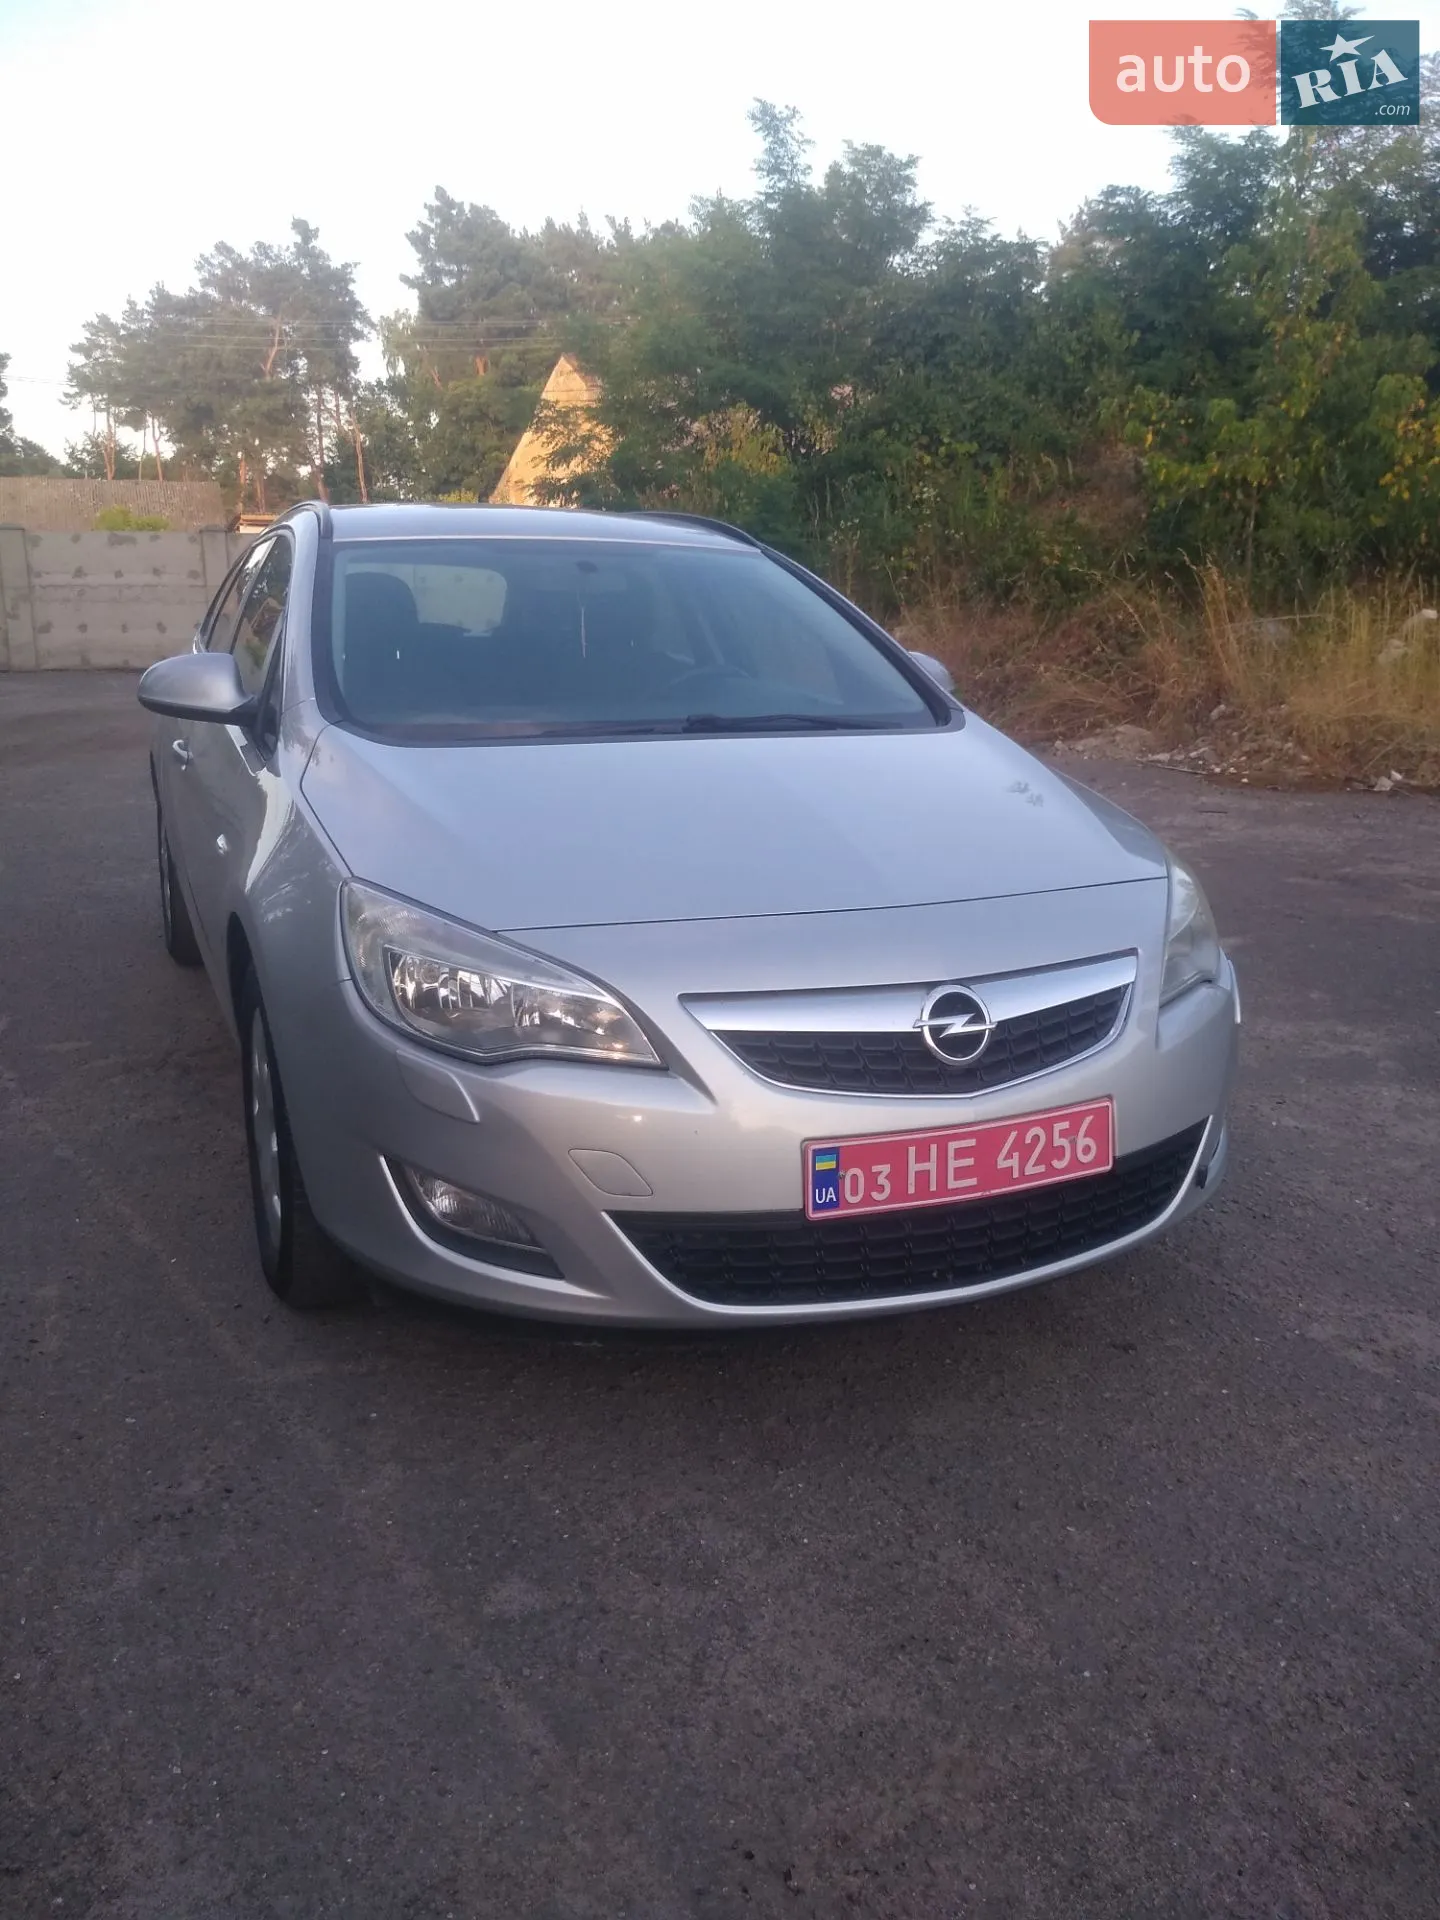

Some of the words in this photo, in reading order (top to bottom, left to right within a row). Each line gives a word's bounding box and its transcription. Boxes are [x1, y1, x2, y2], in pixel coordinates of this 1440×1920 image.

[844, 1163, 891, 1204] 03
[907, 1138, 978, 1194] HE
[996, 1115, 1097, 1179] 4256
[815, 1187, 837, 1204] UA
